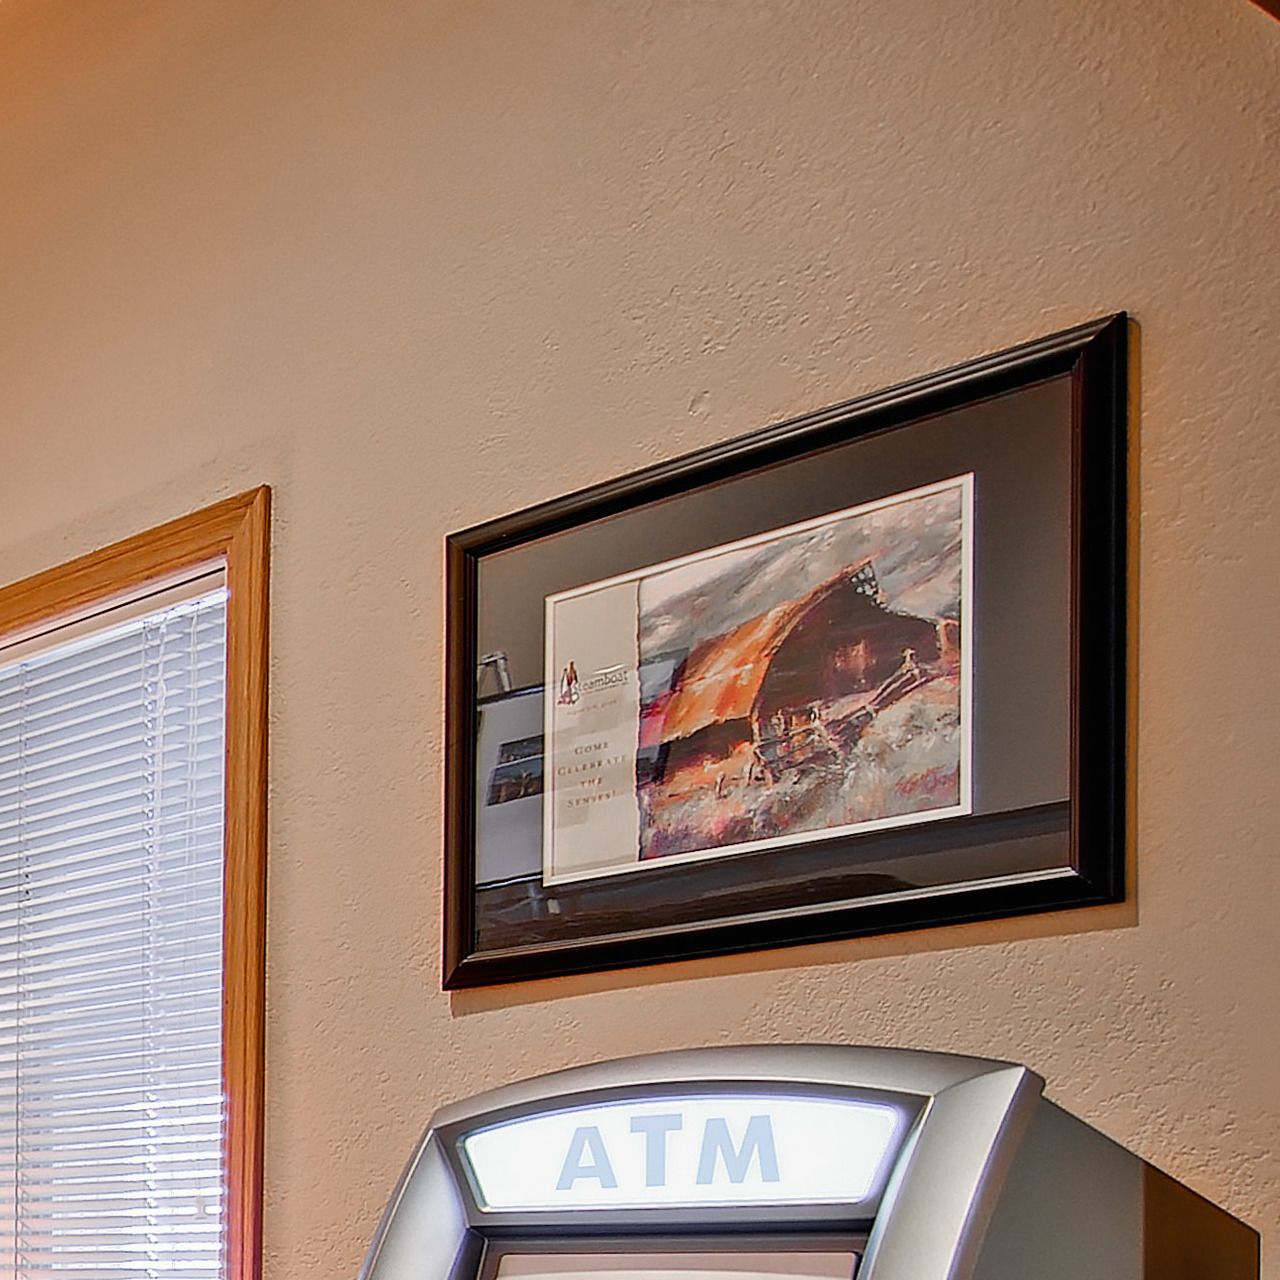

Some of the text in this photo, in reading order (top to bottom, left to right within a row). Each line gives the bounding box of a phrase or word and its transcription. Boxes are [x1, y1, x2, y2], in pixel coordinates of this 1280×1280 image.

[573, 670, 628, 701] Steamboat
[557, 755, 625, 776] CELEBRATE
[556, 1113, 780, 1190] ATM
